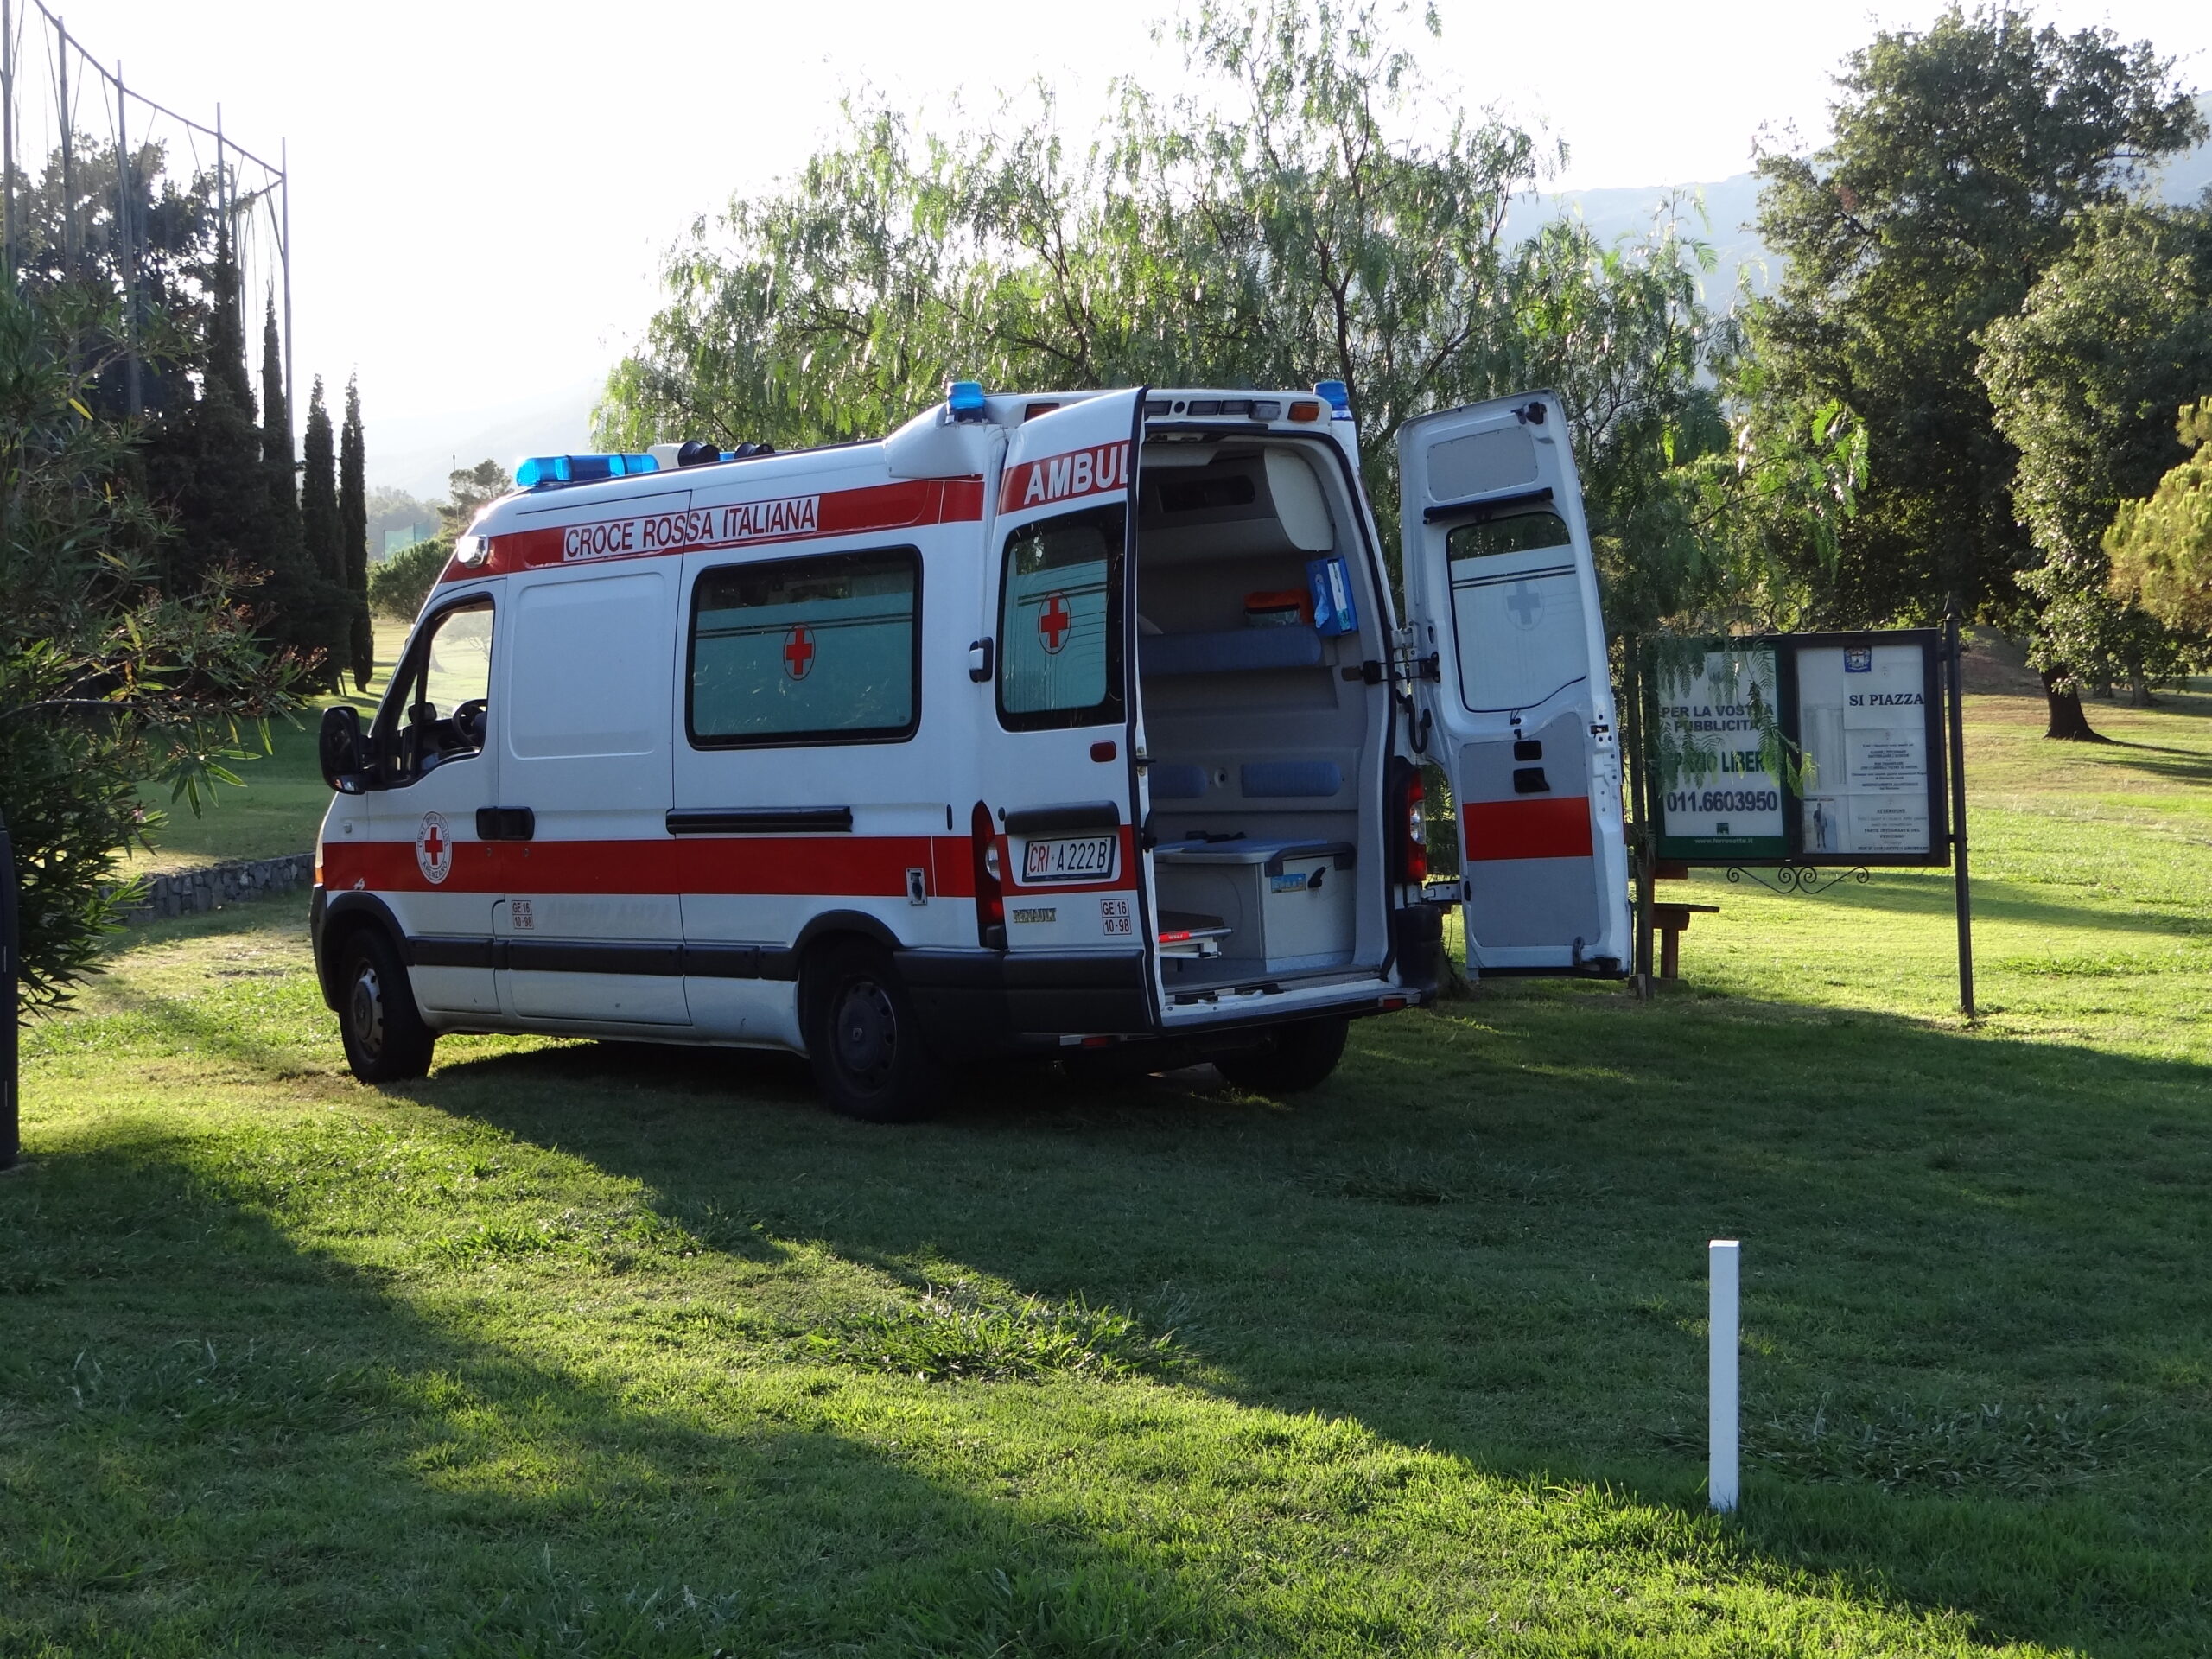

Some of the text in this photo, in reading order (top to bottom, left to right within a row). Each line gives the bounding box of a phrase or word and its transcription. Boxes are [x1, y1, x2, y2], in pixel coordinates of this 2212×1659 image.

[1024, 444, 1128, 505] AMBUL
[566, 499, 816, 558] CROCE ROSSA ITALIANA
[1849, 693, 1925, 706] SI PIAZZA
[1662, 704, 1774, 718] PER LA VOSTA
[1722, 750, 1774, 772] LIBER
[1667, 791, 1778, 812] 011.6603950
[1029, 845, 1050, 873] CRI
[513, 902, 531, 913] GE 16
[1013, 908, 1057, 924] RENAULT
[1103, 901, 1127, 915] GE 16
